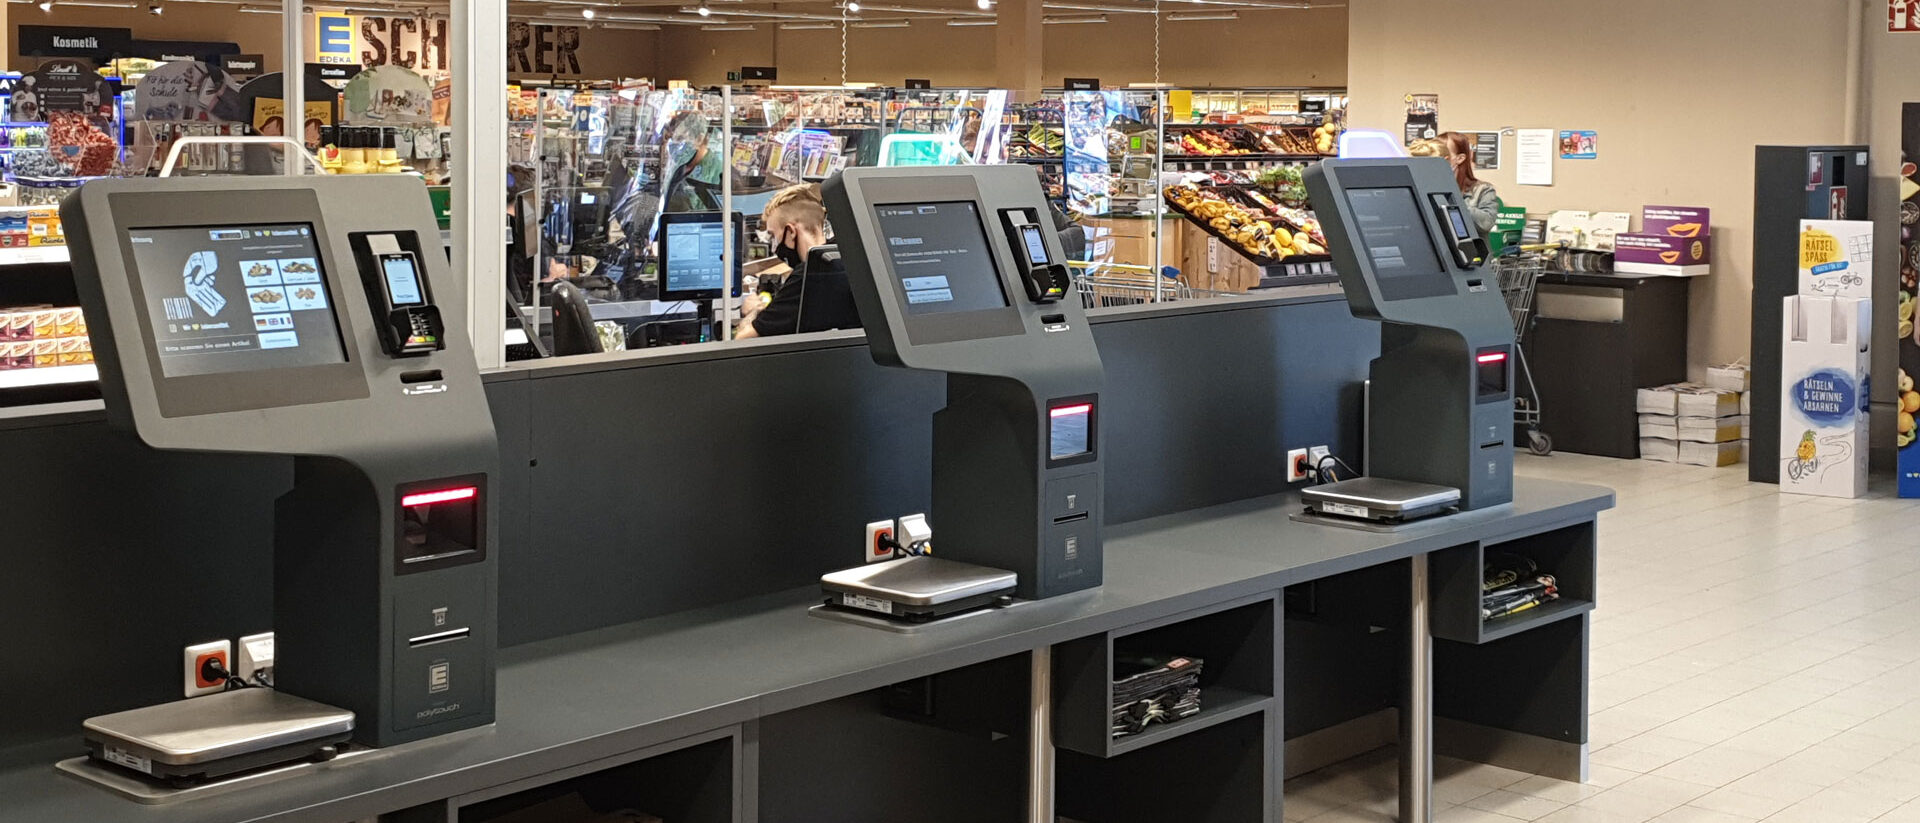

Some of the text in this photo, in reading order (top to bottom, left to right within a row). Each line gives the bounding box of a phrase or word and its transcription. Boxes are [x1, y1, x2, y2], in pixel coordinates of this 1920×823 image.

[53, 35, 98, 48] Kosmetik
[319, 55, 352, 63] EDEKA
[1805, 238, 1833, 251] RÄTSEL
[1804, 251, 1828, 263] SPASS
[1803, 379, 1834, 390] RÄTSELN
[1811, 392, 1844, 403] GEWINNE
[1803, 402, 1840, 413] ABSAHNEN
[416, 703, 460, 719] polytouch
